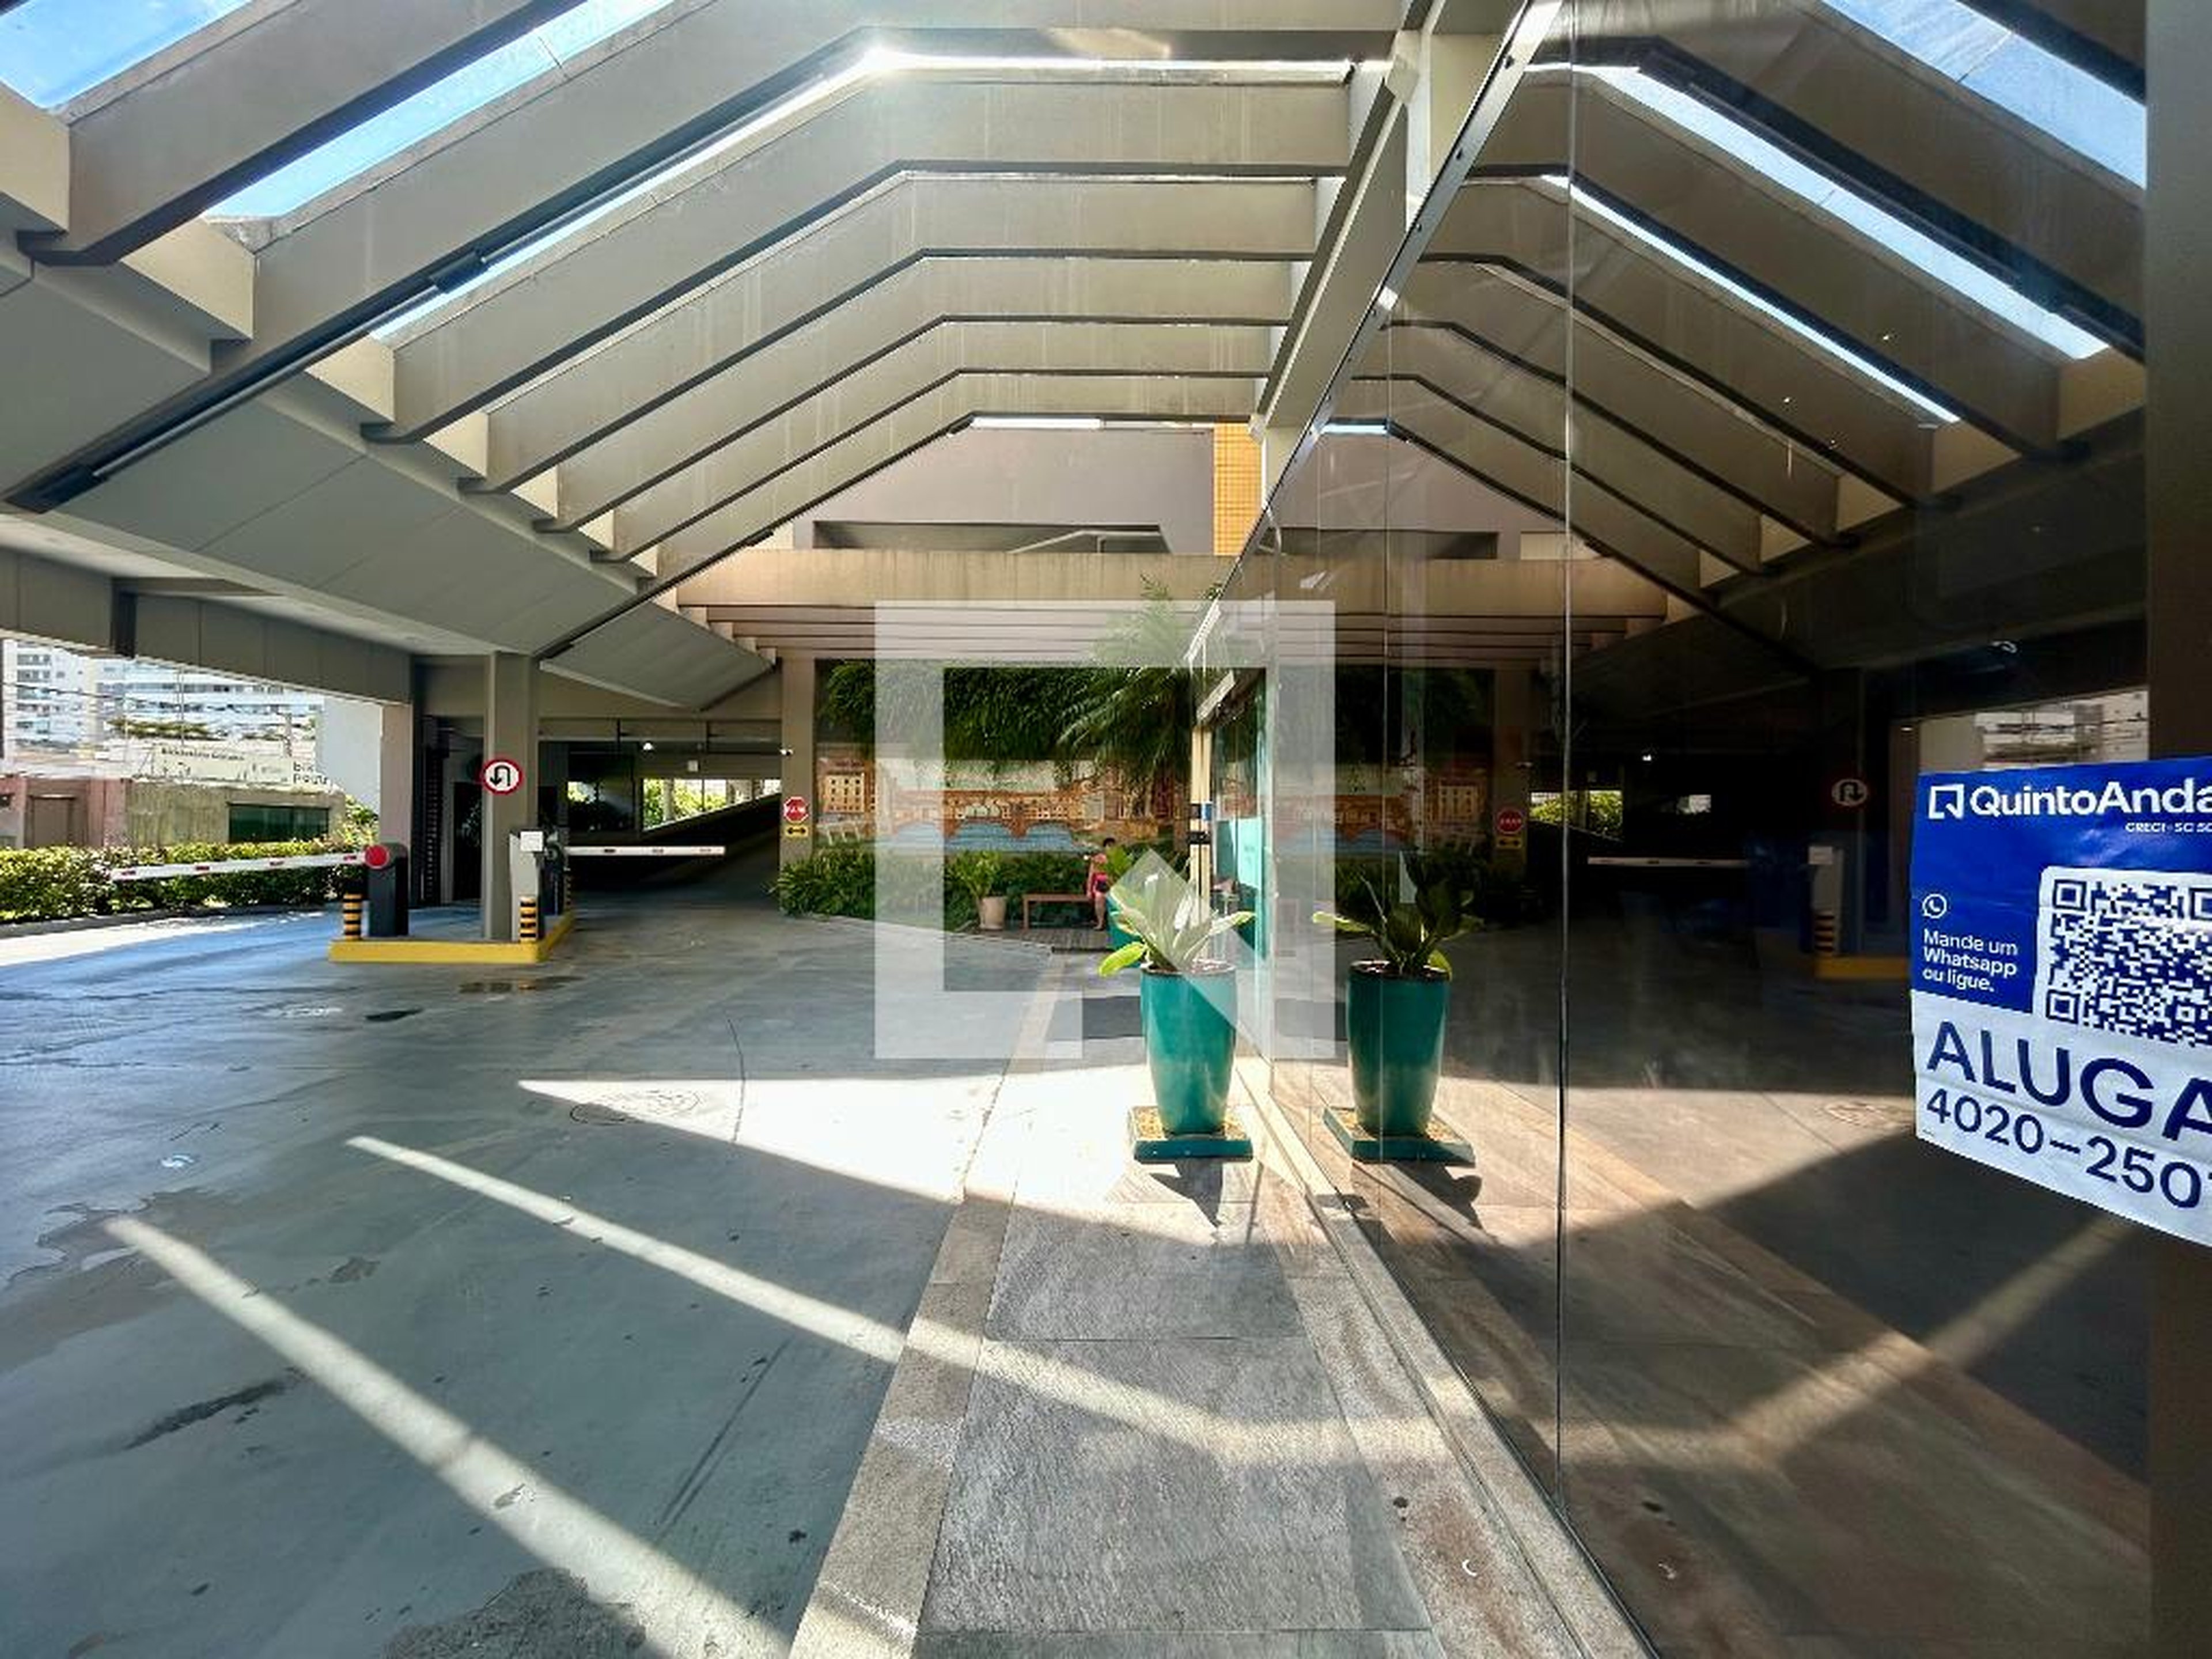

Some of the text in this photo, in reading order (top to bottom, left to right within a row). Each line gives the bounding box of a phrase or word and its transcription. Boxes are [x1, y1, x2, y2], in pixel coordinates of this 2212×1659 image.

[1924, 929, 2017, 956] Mande um
[1924, 946, 2017, 978] Whatsapp
[1922, 968, 1994, 992] ou ligue.
[1927, 1021, 2212, 1141] ALUGA
[1926, 1088, 2212, 1209] 4020-250
